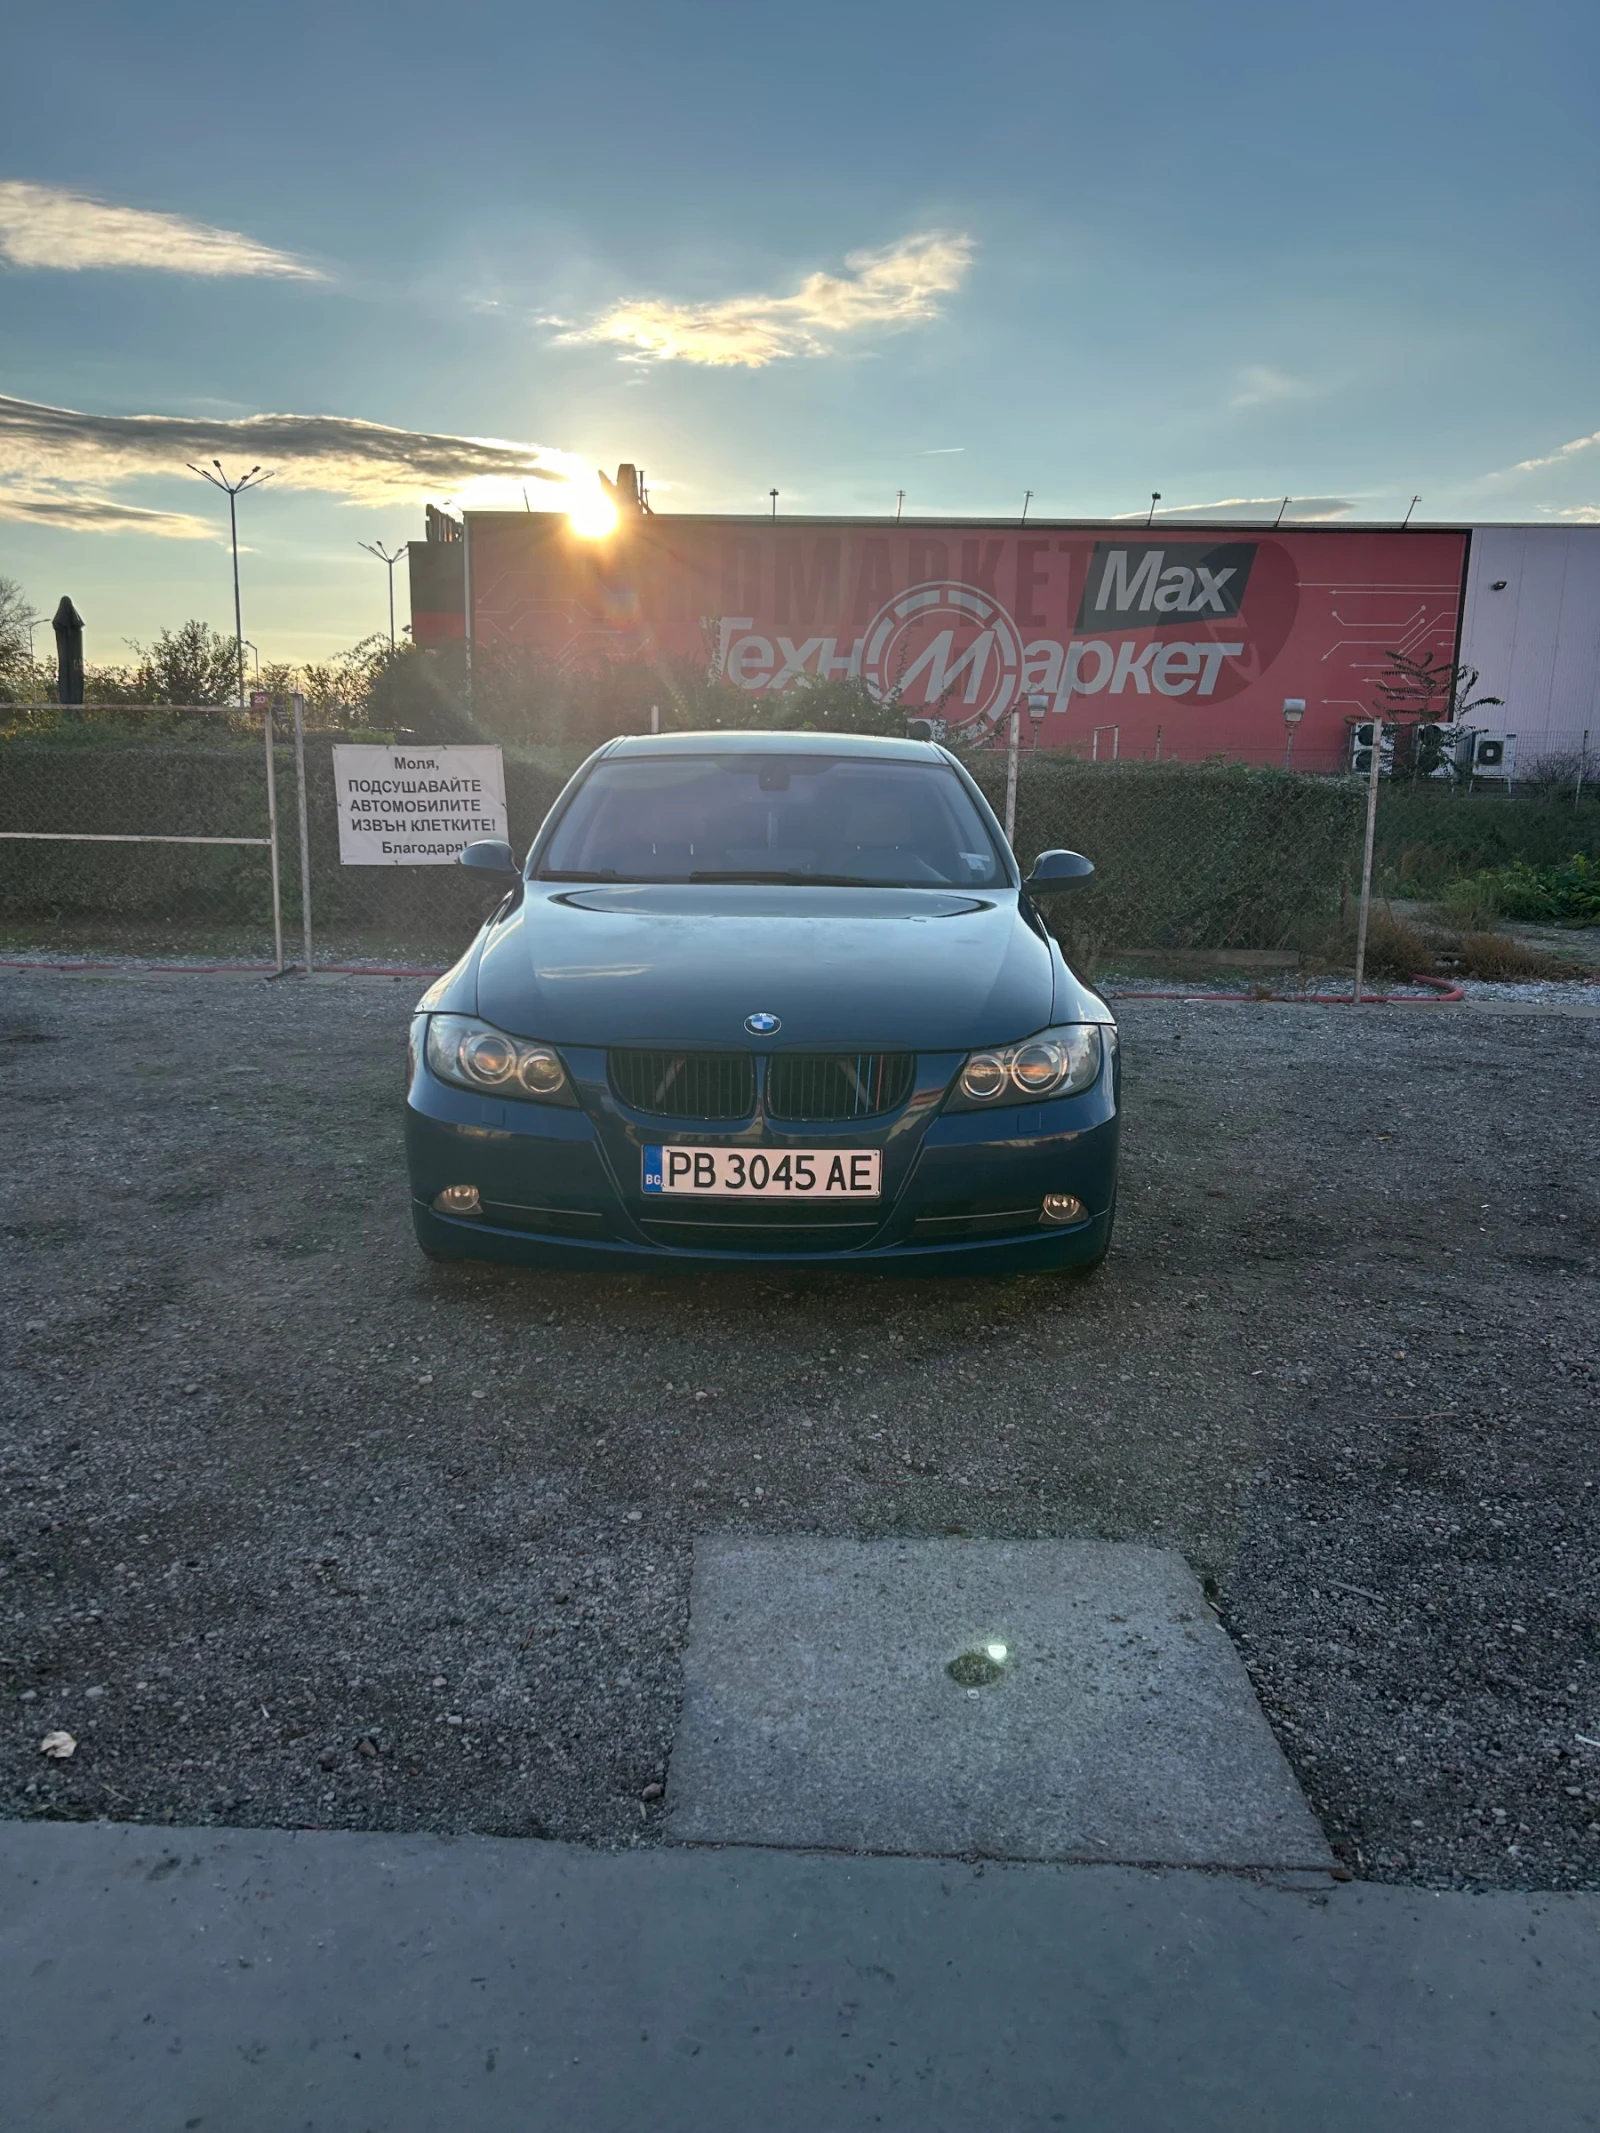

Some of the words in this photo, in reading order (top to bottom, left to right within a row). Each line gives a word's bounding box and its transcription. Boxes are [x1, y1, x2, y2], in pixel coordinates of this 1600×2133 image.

[1095, 550, 1238, 612] Max
[394, 757, 440, 771] Моля,
[348, 776, 482, 795] ПОДСУШАВАЙТЕ
[350, 799, 481, 813] АВТОМОБИЛИТЕ
[351, 818, 407, 832] ИЗВЪН
[411, 818, 496, 832] КЛЕТКИТЕ!
[382, 841, 468, 856] Благодаря!
[669, 1151, 716, 1188] PB
[725, 1154, 817, 1191] 3045
[826, 1155, 872, 1191] AE
[646, 1174, 661, 1185] BG
